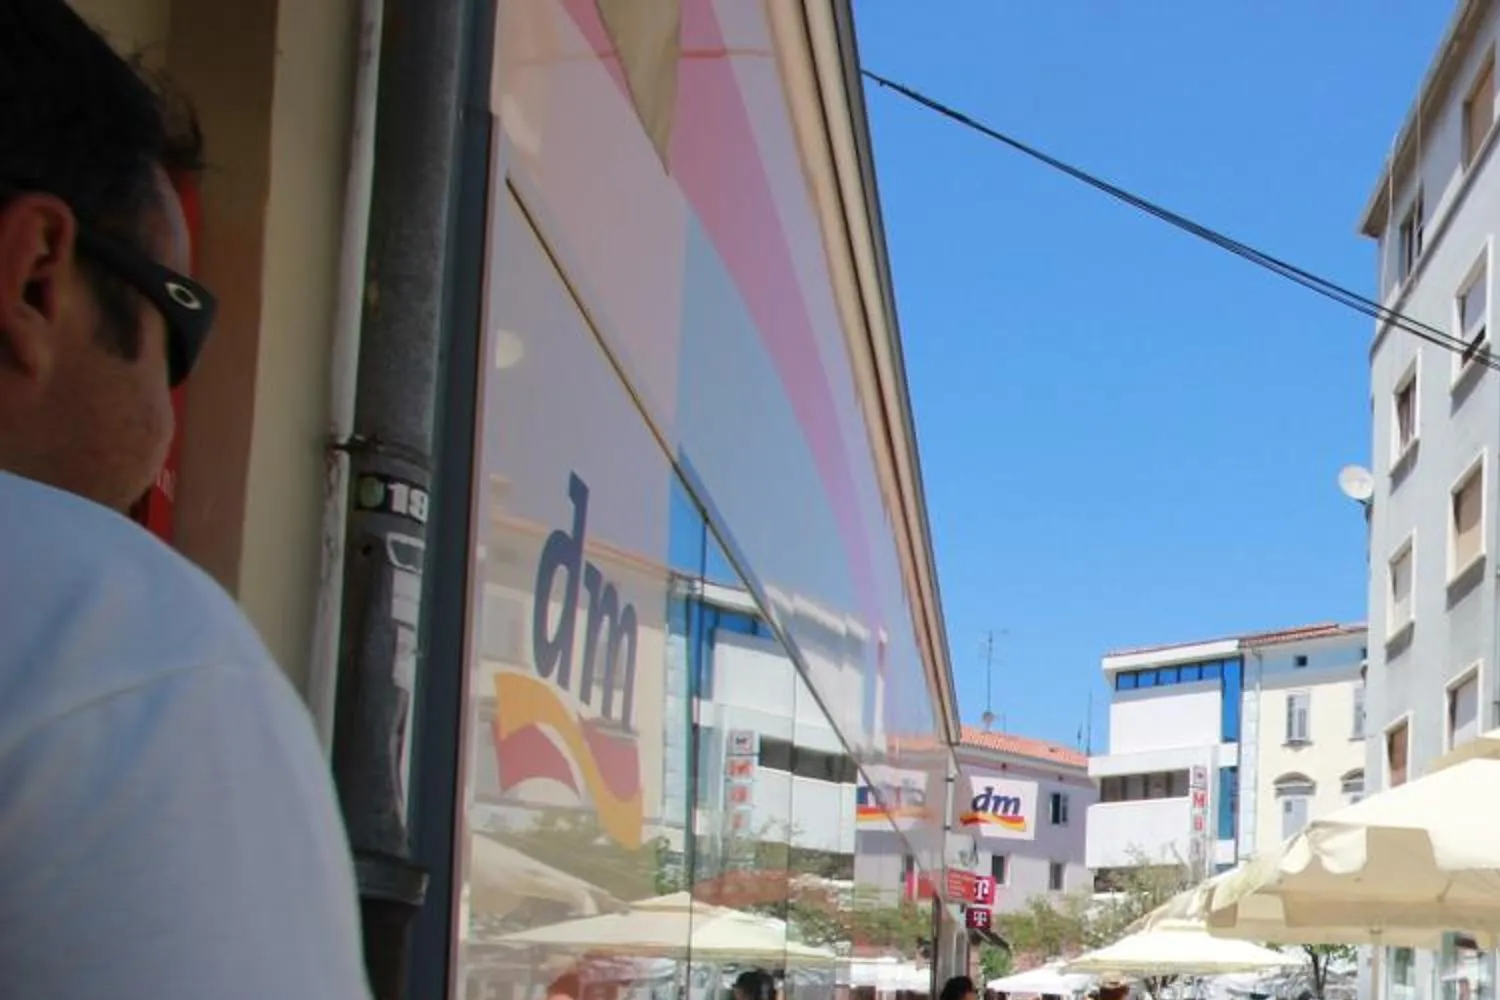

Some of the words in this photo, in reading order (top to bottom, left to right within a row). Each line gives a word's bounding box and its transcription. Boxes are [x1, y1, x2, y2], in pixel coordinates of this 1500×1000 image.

[533, 469, 638, 732] dm
[972, 786, 1020, 816] dm
[973, 879, 990, 901] T
[973, 910, 987, 927] T
